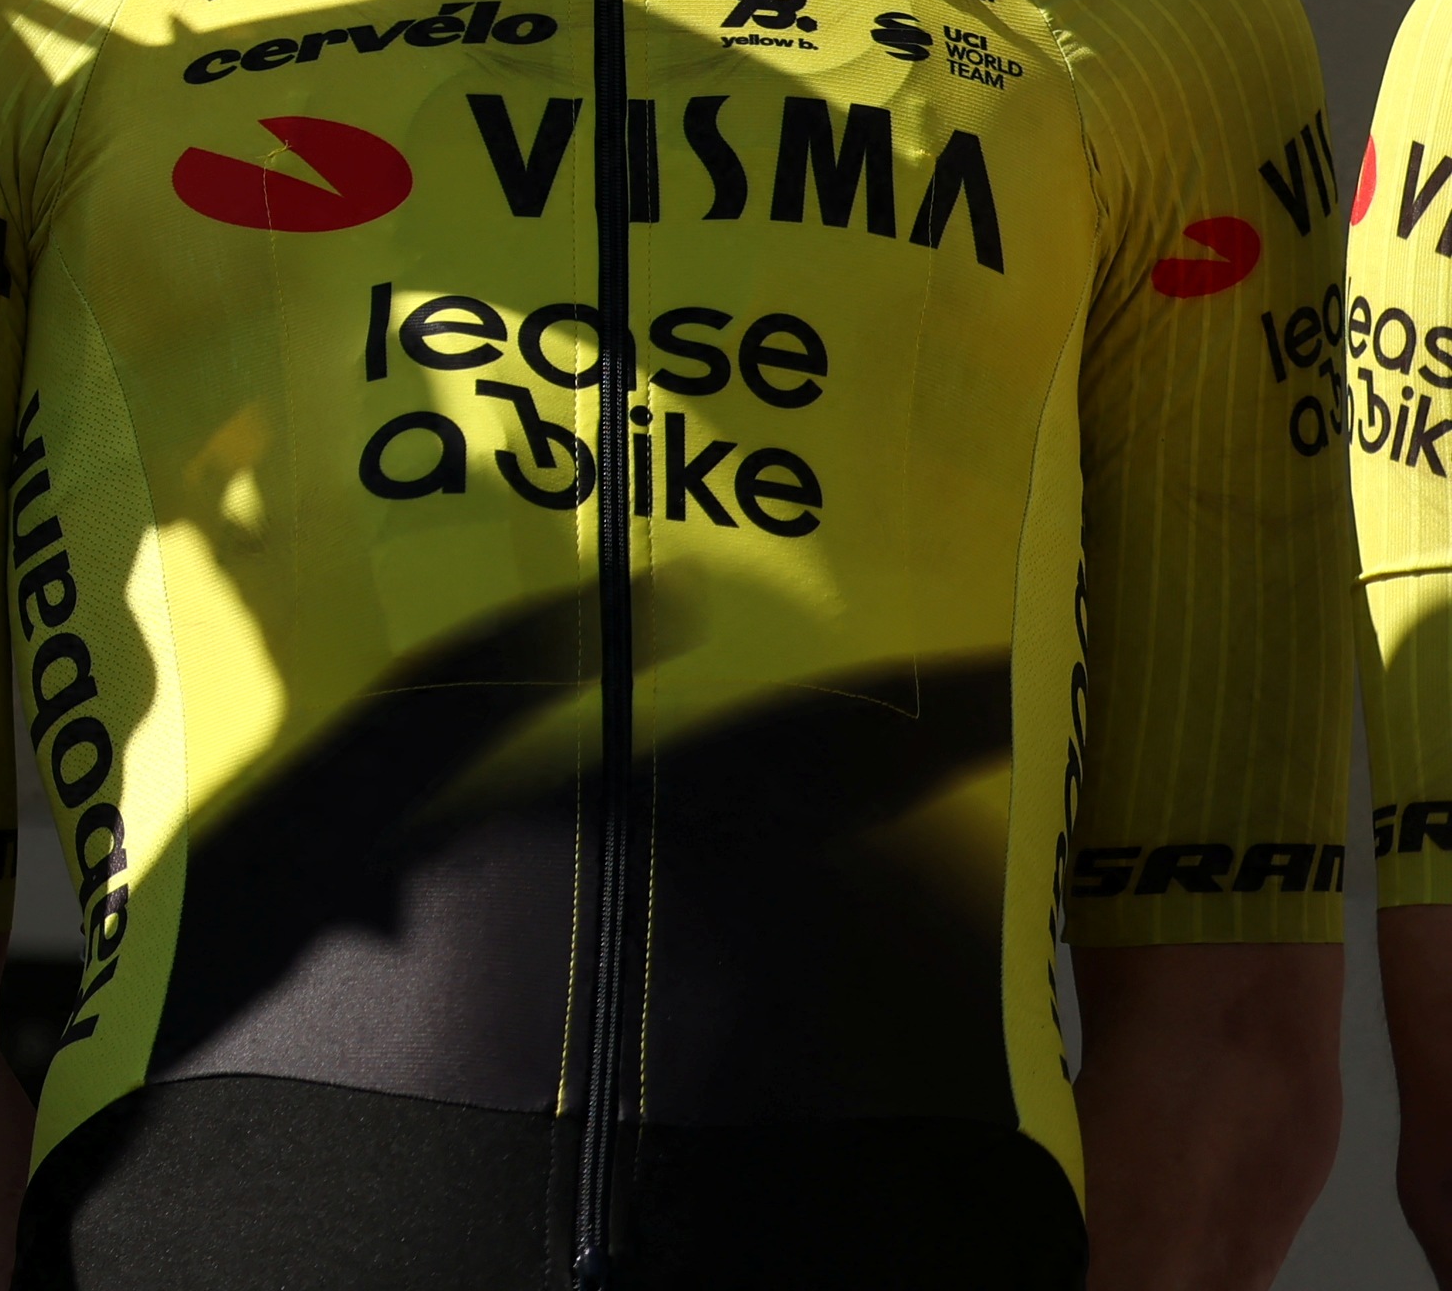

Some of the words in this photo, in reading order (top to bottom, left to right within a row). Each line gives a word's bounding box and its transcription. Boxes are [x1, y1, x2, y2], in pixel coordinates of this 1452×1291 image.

[183, 1, 558, 84] cervélo
[721, 34, 795, 49] yellow
[944, 25, 988, 51] UCI
[945, 43, 1024, 79] WORLD
[947, 59, 1005, 91] TEAM
[466, 93, 1005, 276] VISMA
[365, 282, 829, 409] lease
